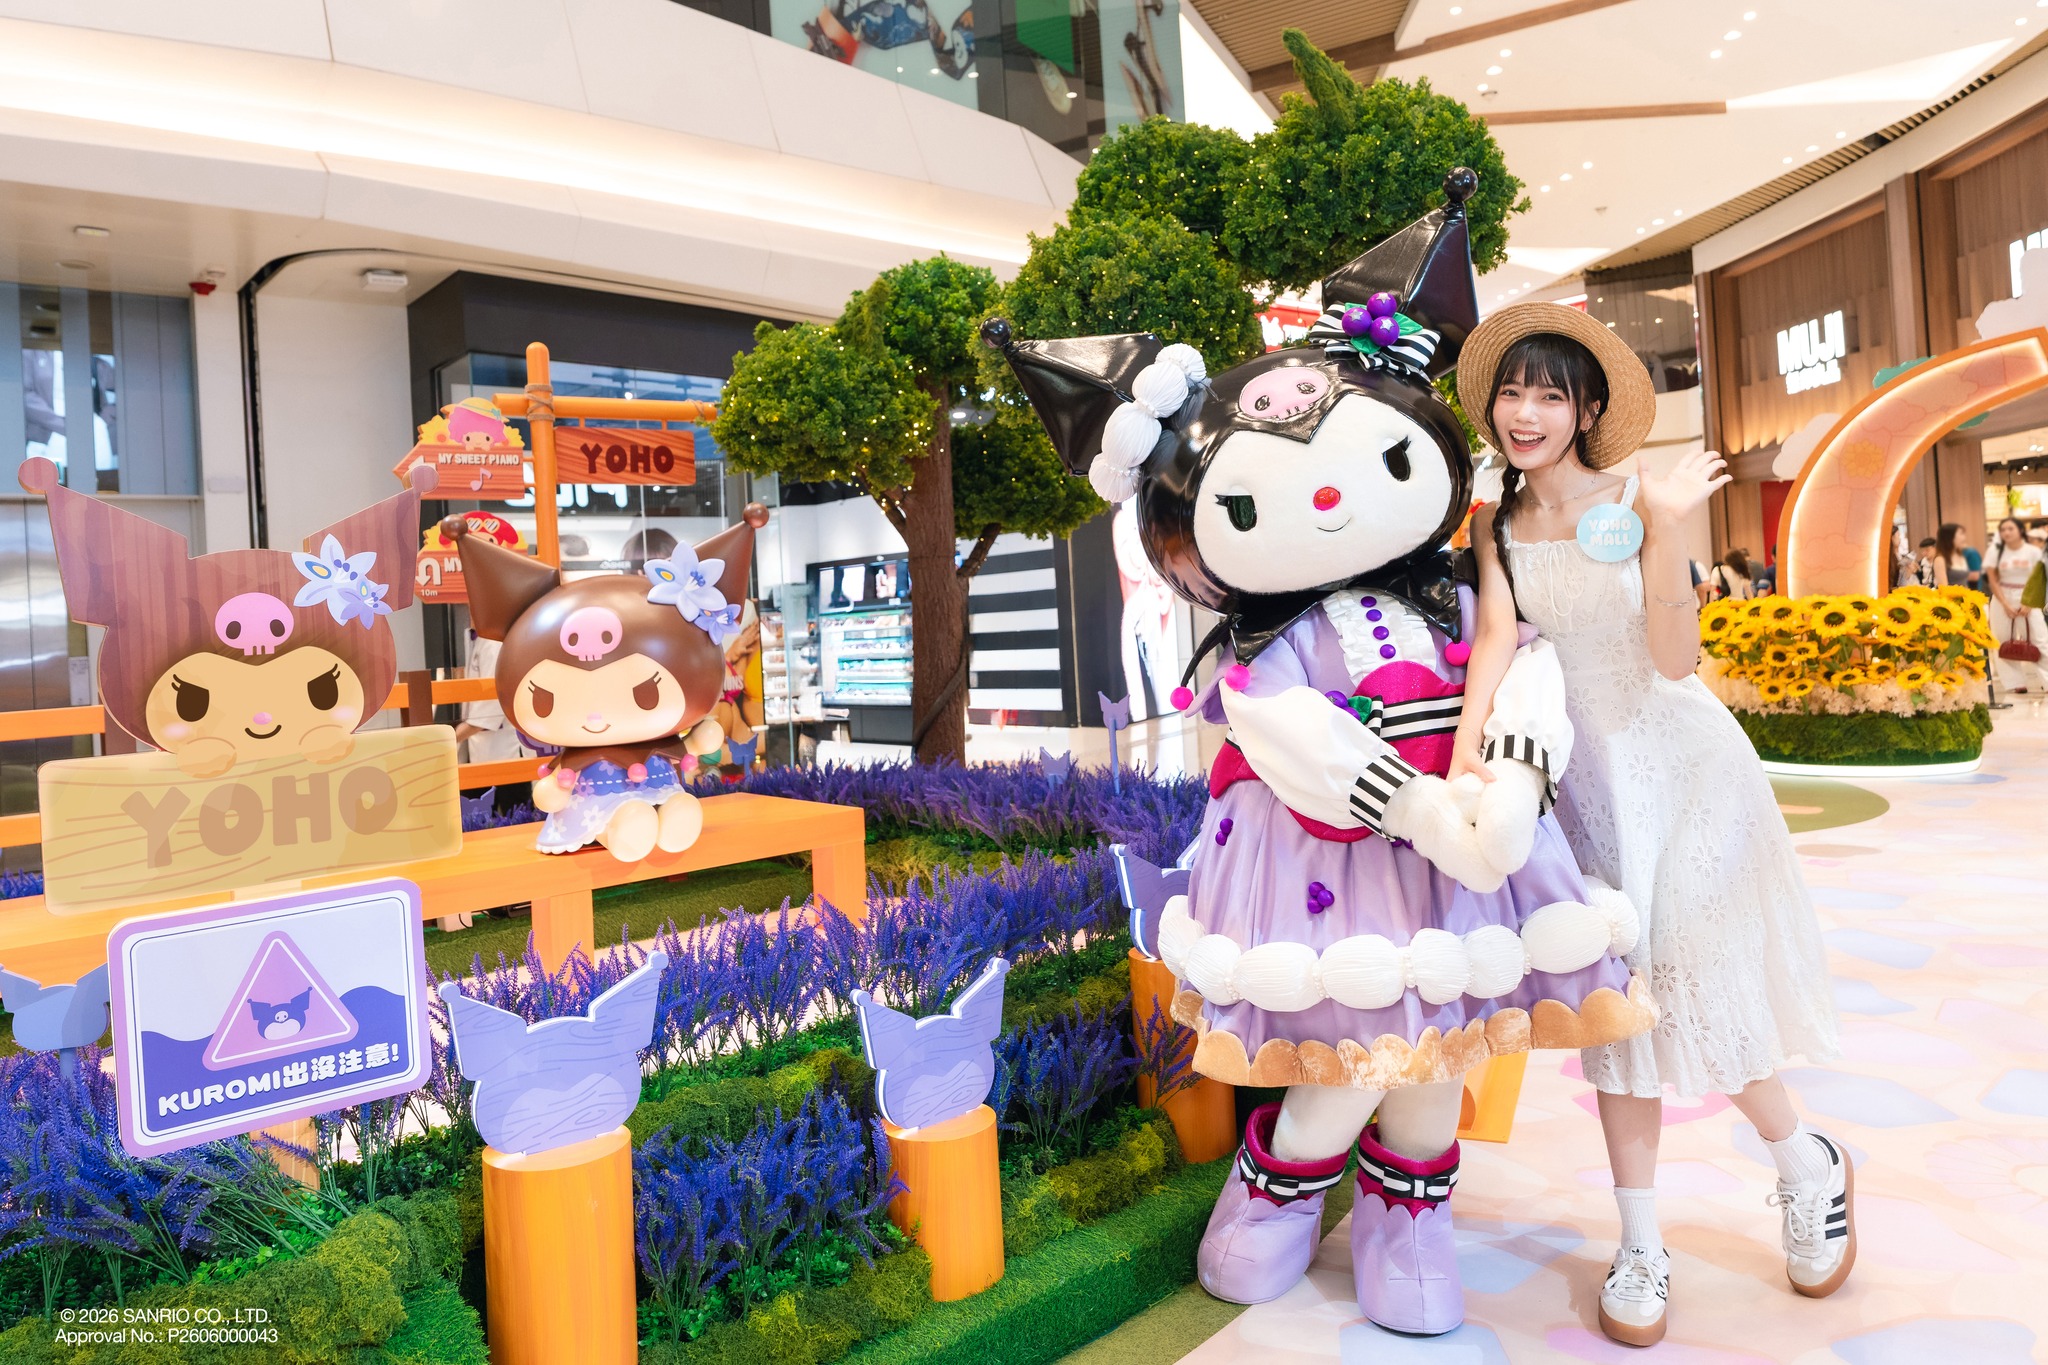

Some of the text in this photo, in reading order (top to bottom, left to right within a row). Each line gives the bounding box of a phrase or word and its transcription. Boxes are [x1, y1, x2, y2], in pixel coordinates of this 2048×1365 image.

[1777, 310, 1845, 375] MUJI
[438, 453, 519, 465] MY SWEET PIANO
[580, 443, 675, 474] YOHO
[1588, 519, 1632, 531] YOHO
[1590, 533, 1630, 546] MALL
[420, 589, 438, 597] 10m
[120, 765, 398, 869] YOHO
